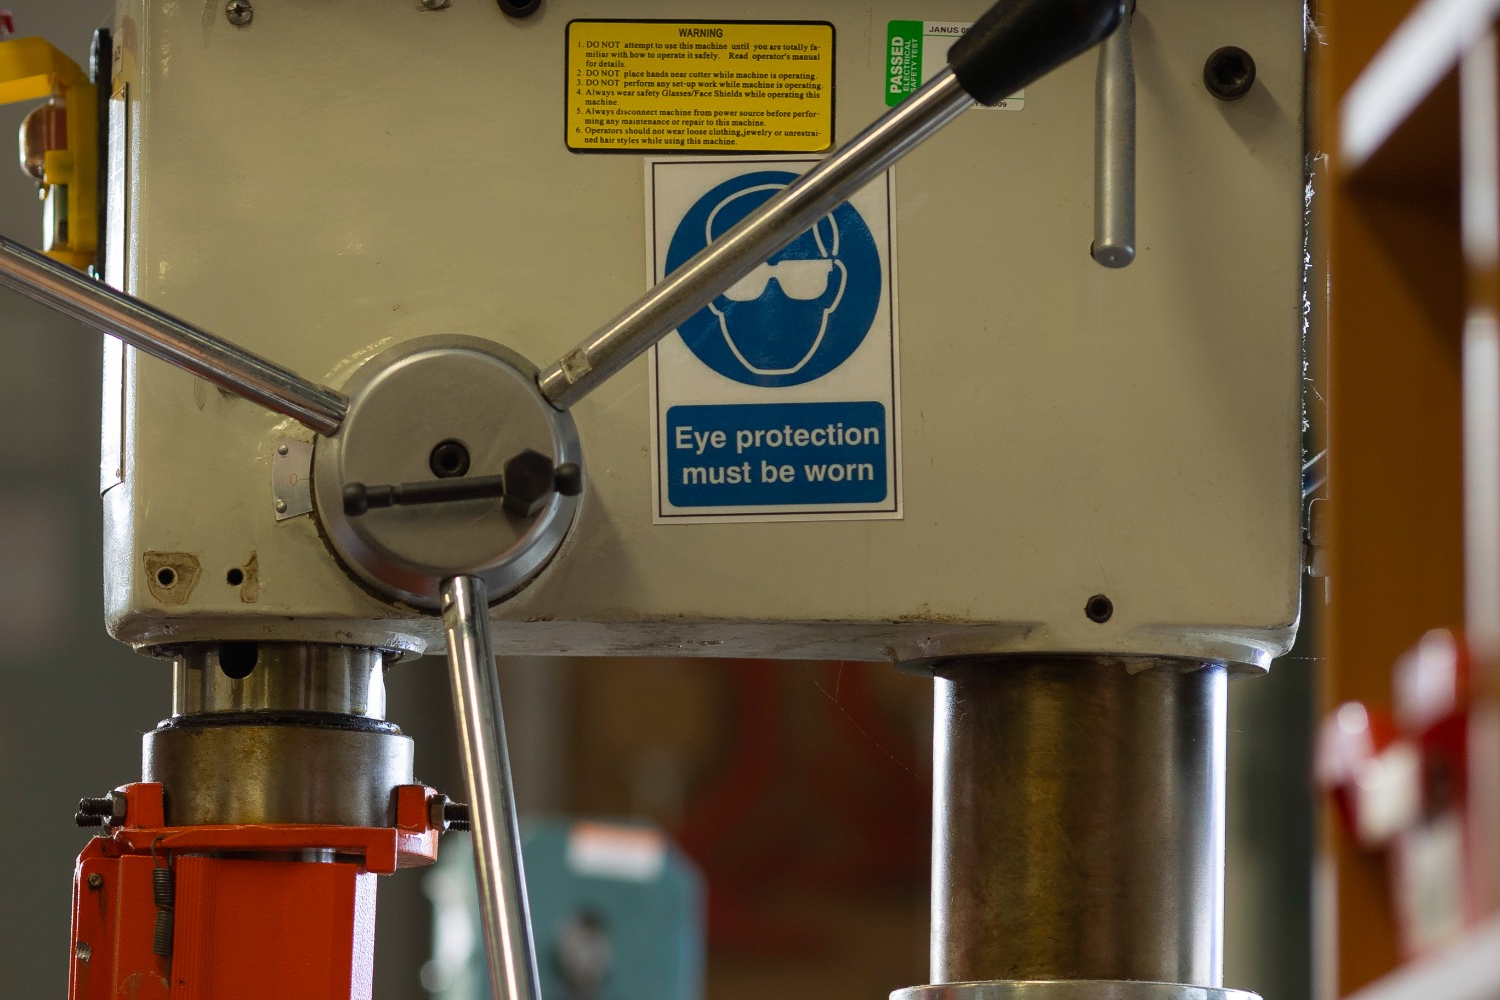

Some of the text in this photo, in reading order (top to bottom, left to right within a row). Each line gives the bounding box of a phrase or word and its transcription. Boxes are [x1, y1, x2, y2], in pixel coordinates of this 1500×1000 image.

[678, 28, 723, 38] WARNING
[624, 42, 654, 50] attempt
[679, 42, 694, 50] this
[695, 42, 728, 50] machine
[732, 42, 750, 50] until
[783, 44, 808, 52] totally
[657, 52, 686, 60] operate
[694, 52, 720, 60] safely.
[729, 52, 748, 60] Read
[752, 53, 790, 61] operator's
[598, 60, 626, 68] details.
[890, 36, 904, 94] PASSED
[903, 40, 911, 92] ELECTRICAL
[624, 70, 644, 78] place
[778, 72, 817, 80] operating.
[910, 60, 918, 92] SAFETY
[624, 80, 654, 88] perform
[672, 81, 696, 89] set-up
[784, 82, 823, 90] operating.
[636, 90, 660, 98] safety
[744, 90, 766, 98] while
[768, 91, 804, 100] operating
[585, 108, 614, 116] Always
[616, 108, 658, 116] disconnect
[714, 110, 738, 118] power
[585, 118, 604, 126] ming
[585, 127, 623, 135] Operators
[616, 137, 640, 145] styles
[664, 138, 684, 146] using
[675, 422, 880, 455] Eye protection
[682, 460, 874, 485] must be worn
